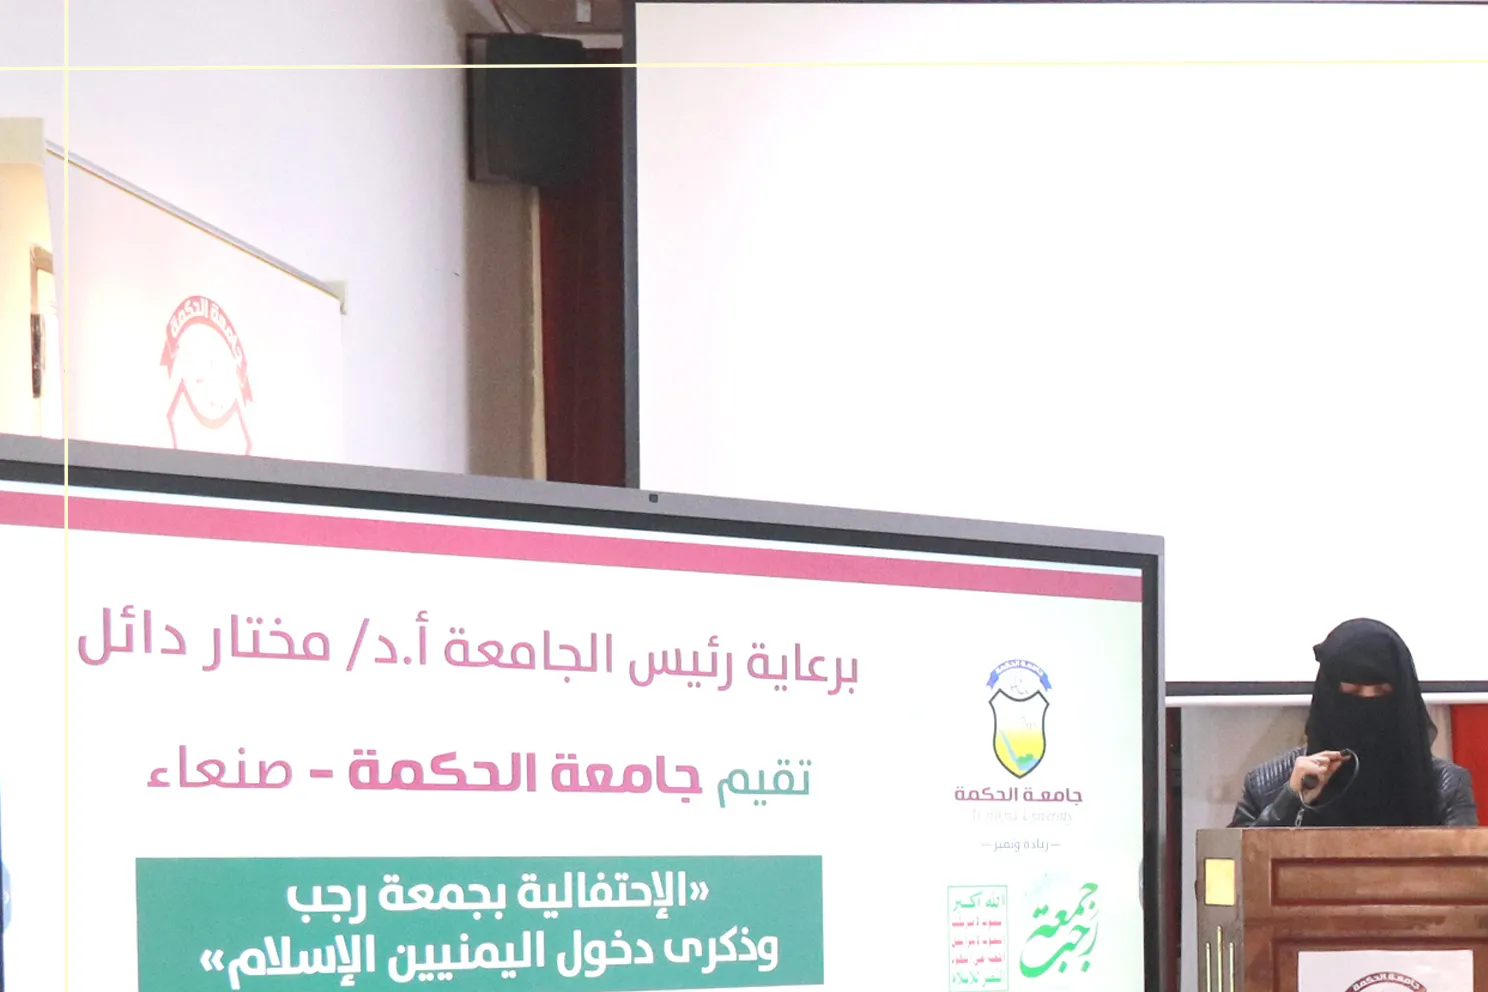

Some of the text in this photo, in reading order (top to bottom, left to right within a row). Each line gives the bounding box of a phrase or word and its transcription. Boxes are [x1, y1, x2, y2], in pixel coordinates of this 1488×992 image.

[77, 604, 187, 666] دائل
[202, 613, 331, 671] مختار
[444, 624, 613, 684] الجامعة
[629, 635, 733, 693] رئيس
[747, 642, 858, 696] برعاية
[146, 745, 293, 790] صنعاء
[348, 749, 538, 793] الحكمة
[551, 752, 703, 804] جامعة
[716, 758, 812, 808] تقيم
[954, 786, 1083, 806] جامعة الحكمة
[286, 882, 369, 923] رجب
[378, 871, 508, 920] بجمعة
[387, 931, 544, 983] اليمنيين
[557, 929, 654, 977] دخول
[664, 927, 779, 973] وذكرى
